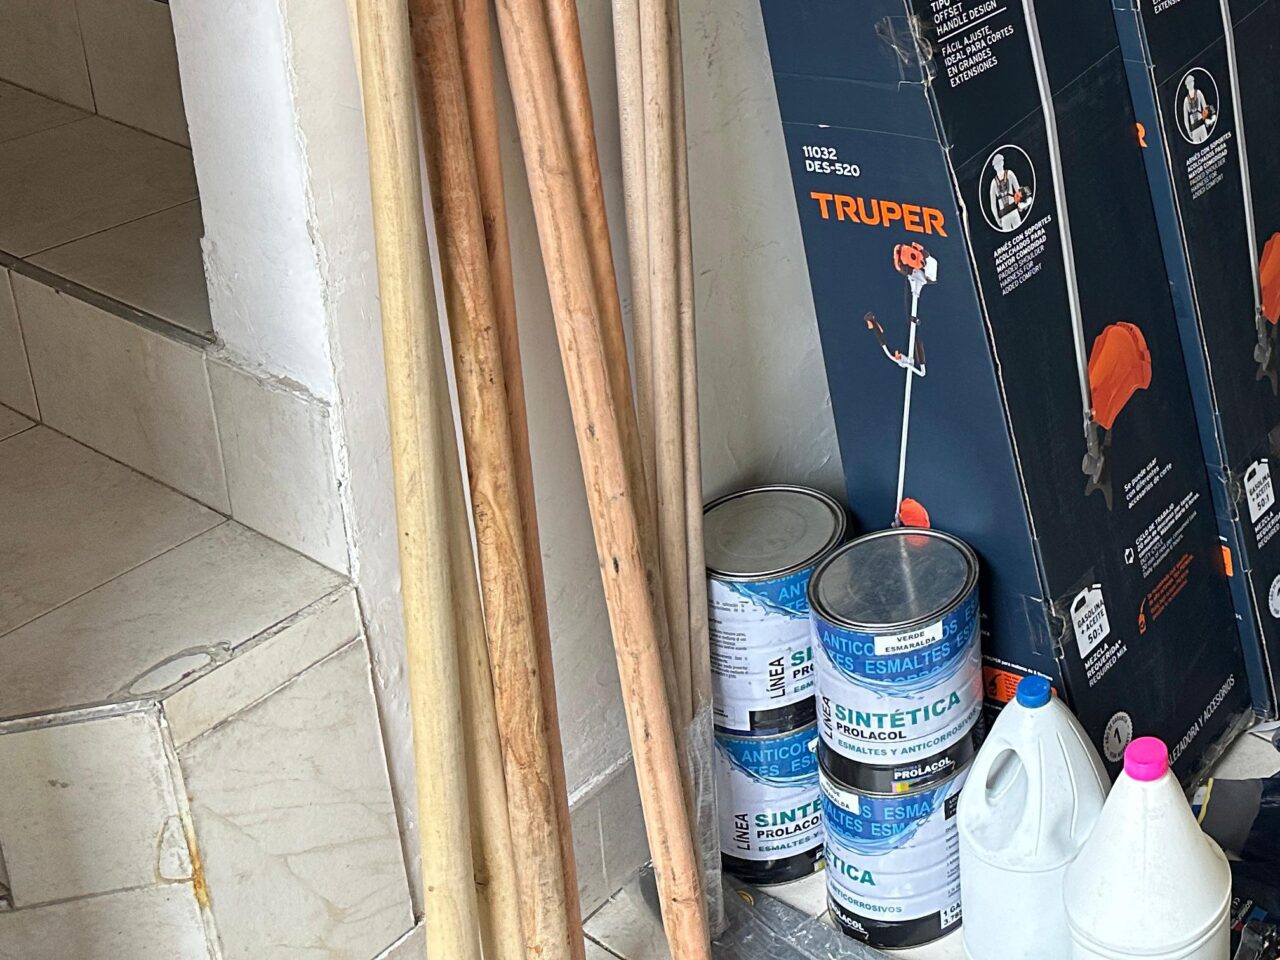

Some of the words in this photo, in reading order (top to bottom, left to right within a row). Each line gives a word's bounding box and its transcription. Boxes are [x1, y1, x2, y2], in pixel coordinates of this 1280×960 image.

[934, 2, 963, 24] OFFSET
[936, 13, 969, 36] HANDLE
[969, 0, 997, 20] DESIGN
[942, 40, 963, 57] FÁCIL
[963, 25, 994, 45] AJUSTE,
[944, 51, 966, 67] IDEAL
[966, 40, 987, 56] PARA
[986, 25, 1014, 45] CORTES
[947, 65, 959, 78] EN
[959, 48, 992, 72] GRANDES
[950, 56, 998, 87] EXTENSIONES
[803, 145, 837, 160] 11032
[805, 160, 861, 177] DES-520
[810, 192, 948, 237] TRUPER
[996, 237, 1031, 266] ACOLCHADOS
[1030, 227, 1046, 241] PARA
[997, 255, 1016, 273] MAYOR
[1015, 234, 1047, 260] COMODIDAD
[1012, 233, 1025, 245] CON
[1077, 598, 1105, 628] GASOLINA
[1086, 608, 1105, 632] ACEITE
[885, 636, 936, 653] ESMARALDA
[896, 631, 925, 642] VERDE
[1088, 623, 1104, 644] 50:1
[865, 642, 951, 674] ESMALTES
[1084, 642, 1109, 670] MEZCLA
[1088, 655, 1117, 688] REQUIRED
[1117, 643, 1128, 659] MIX
[766, 656, 785, 700] LÍNEA
[835, 691, 961, 729] SINTÉTICA
[1198, 715, 1203, 727] Y
[1203, 673, 1235, 723] ACCESORIOS
[836, 722, 907, 741] PROLACOL
[838, 739, 888, 756] ESMALTES
[890, 748, 898, 756] Y
[900, 707, 978, 755] ANTICORROSIVOS
[1113, 727, 1121, 744] 1
[893, 757, 952, 780] PROLACOL
[733, 813, 751, 851] LÍNEA
[759, 836, 806, 852] ESMALTES
